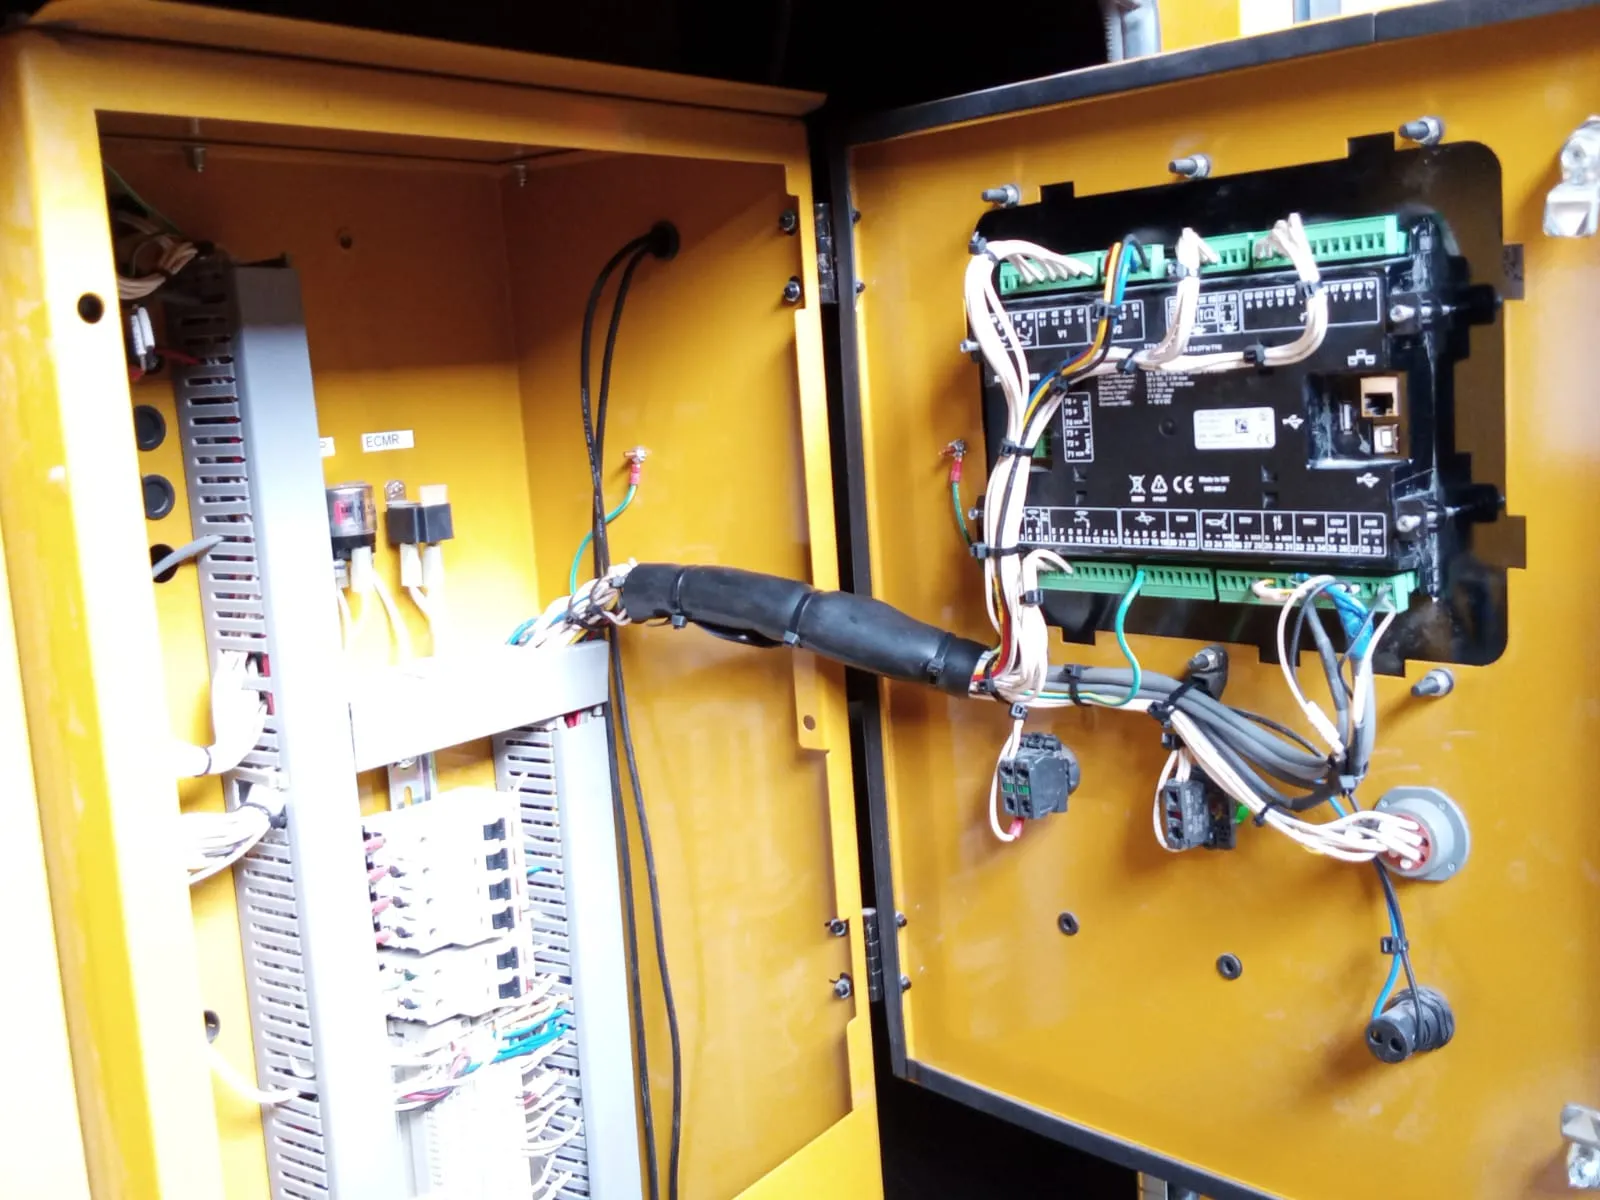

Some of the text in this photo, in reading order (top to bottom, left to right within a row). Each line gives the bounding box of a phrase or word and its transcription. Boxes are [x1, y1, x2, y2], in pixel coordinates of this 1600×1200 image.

[1113, 325, 1123, 334] V2
[1057, 330, 1067, 339] V1
[366, 433, 400, 448] ECMR
